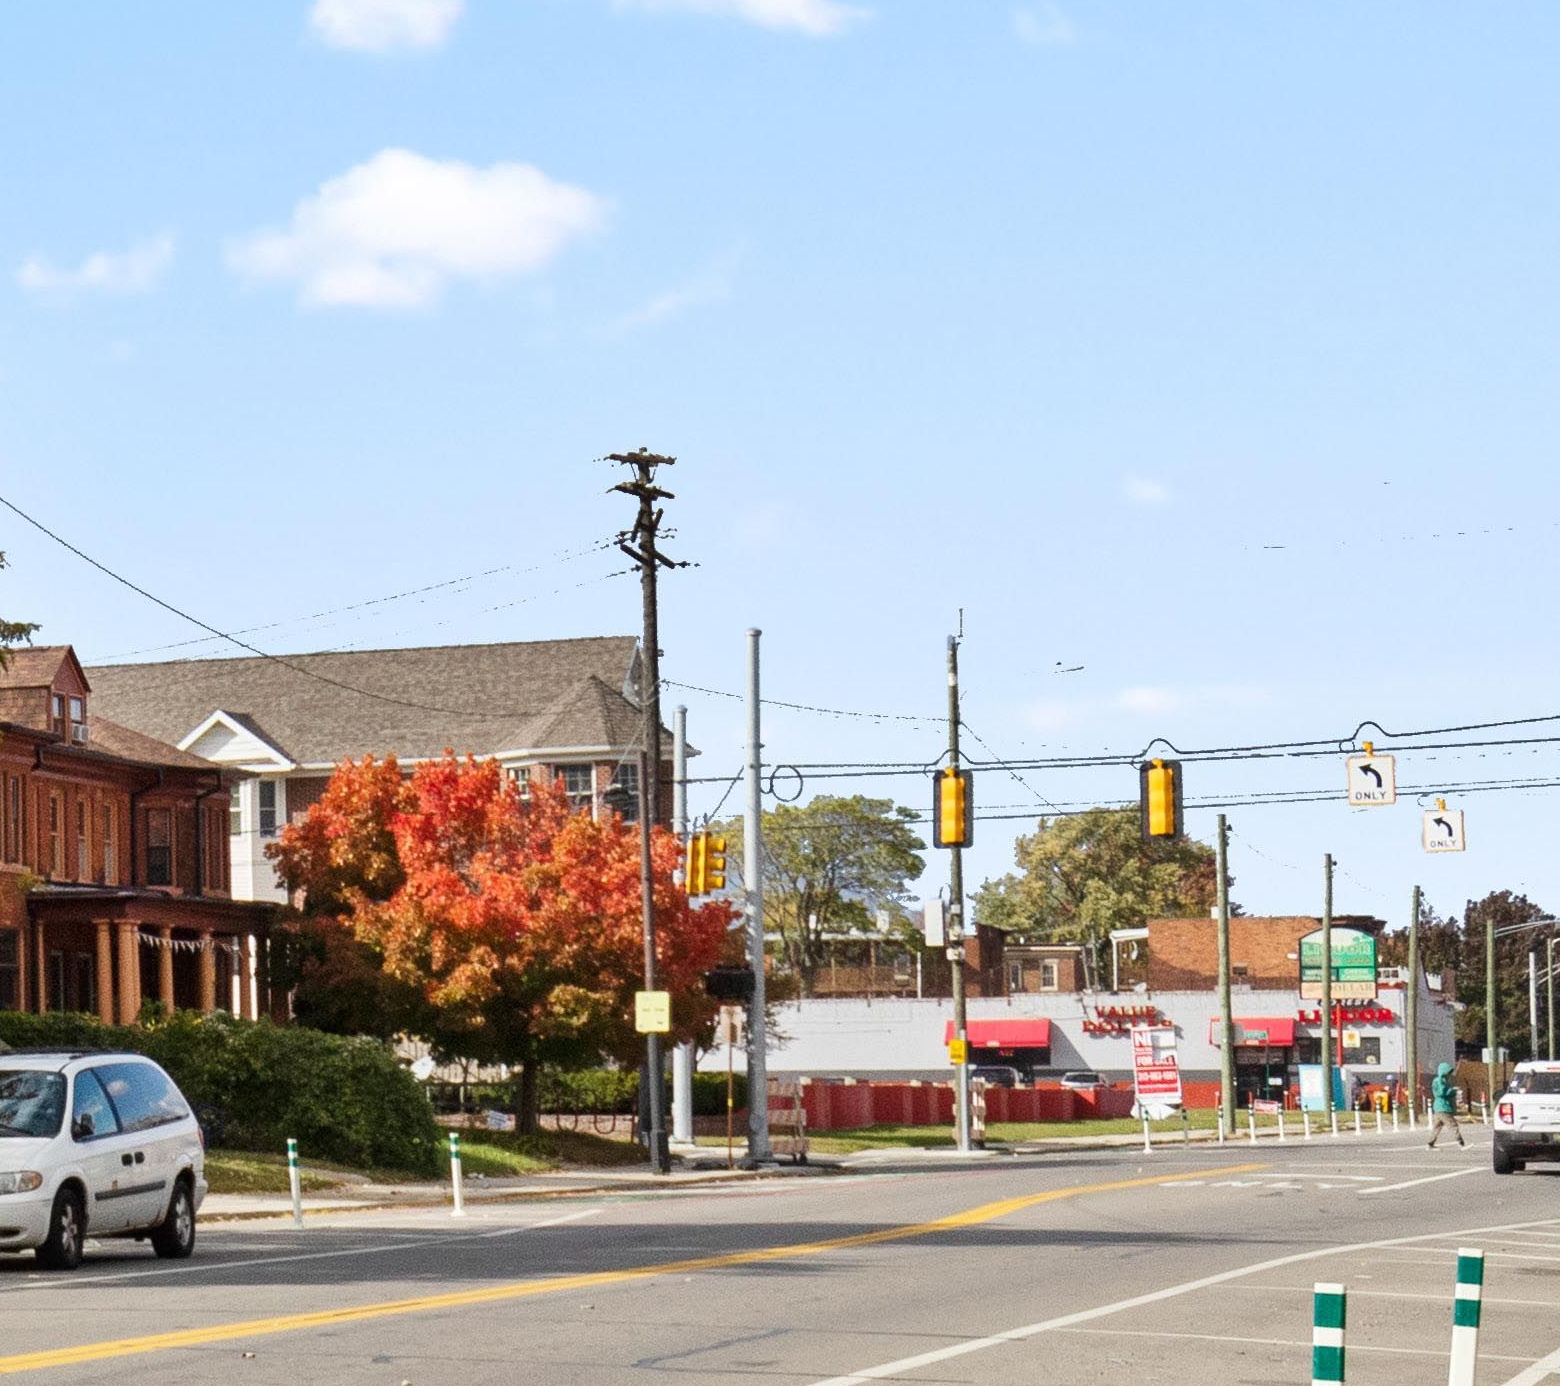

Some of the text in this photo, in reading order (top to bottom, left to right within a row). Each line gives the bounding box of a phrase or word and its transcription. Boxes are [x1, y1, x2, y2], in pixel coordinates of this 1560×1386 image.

[1355, 791, 1386, 800] ONLY
[1430, 840, 1457, 848] ONLY
[1303, 943, 1372, 955] LIUOR
[1095, 1006, 1156, 1018] VALUE
